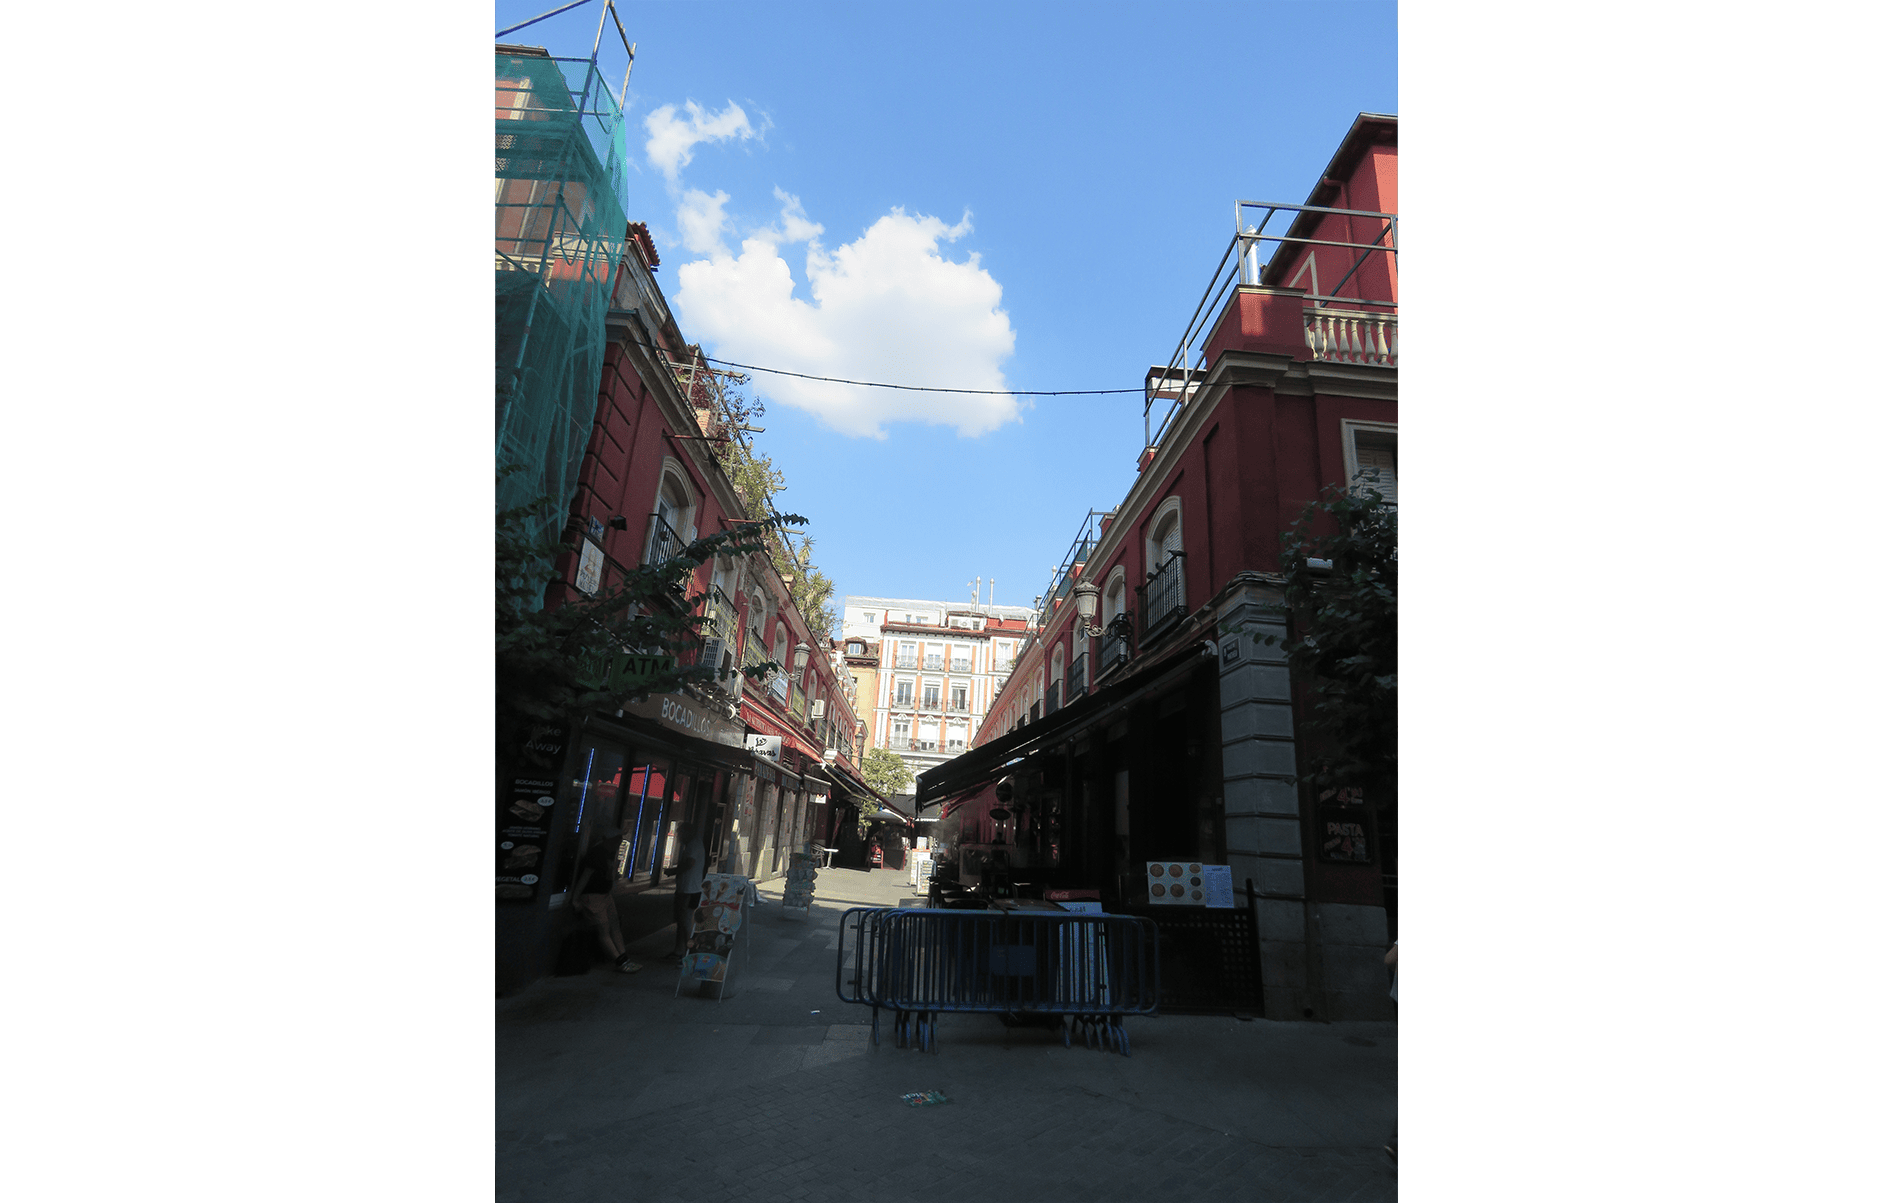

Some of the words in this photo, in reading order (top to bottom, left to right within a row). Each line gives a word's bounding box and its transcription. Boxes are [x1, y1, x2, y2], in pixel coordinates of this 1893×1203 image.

[623, 657, 671, 675] ATM
[661, 697, 710, 733] BOCADILLOS
[526, 739, 562, 755] Away
[515, 779, 554, 787] BOCADILLOS
[1327, 822, 1364, 836] PASTA
